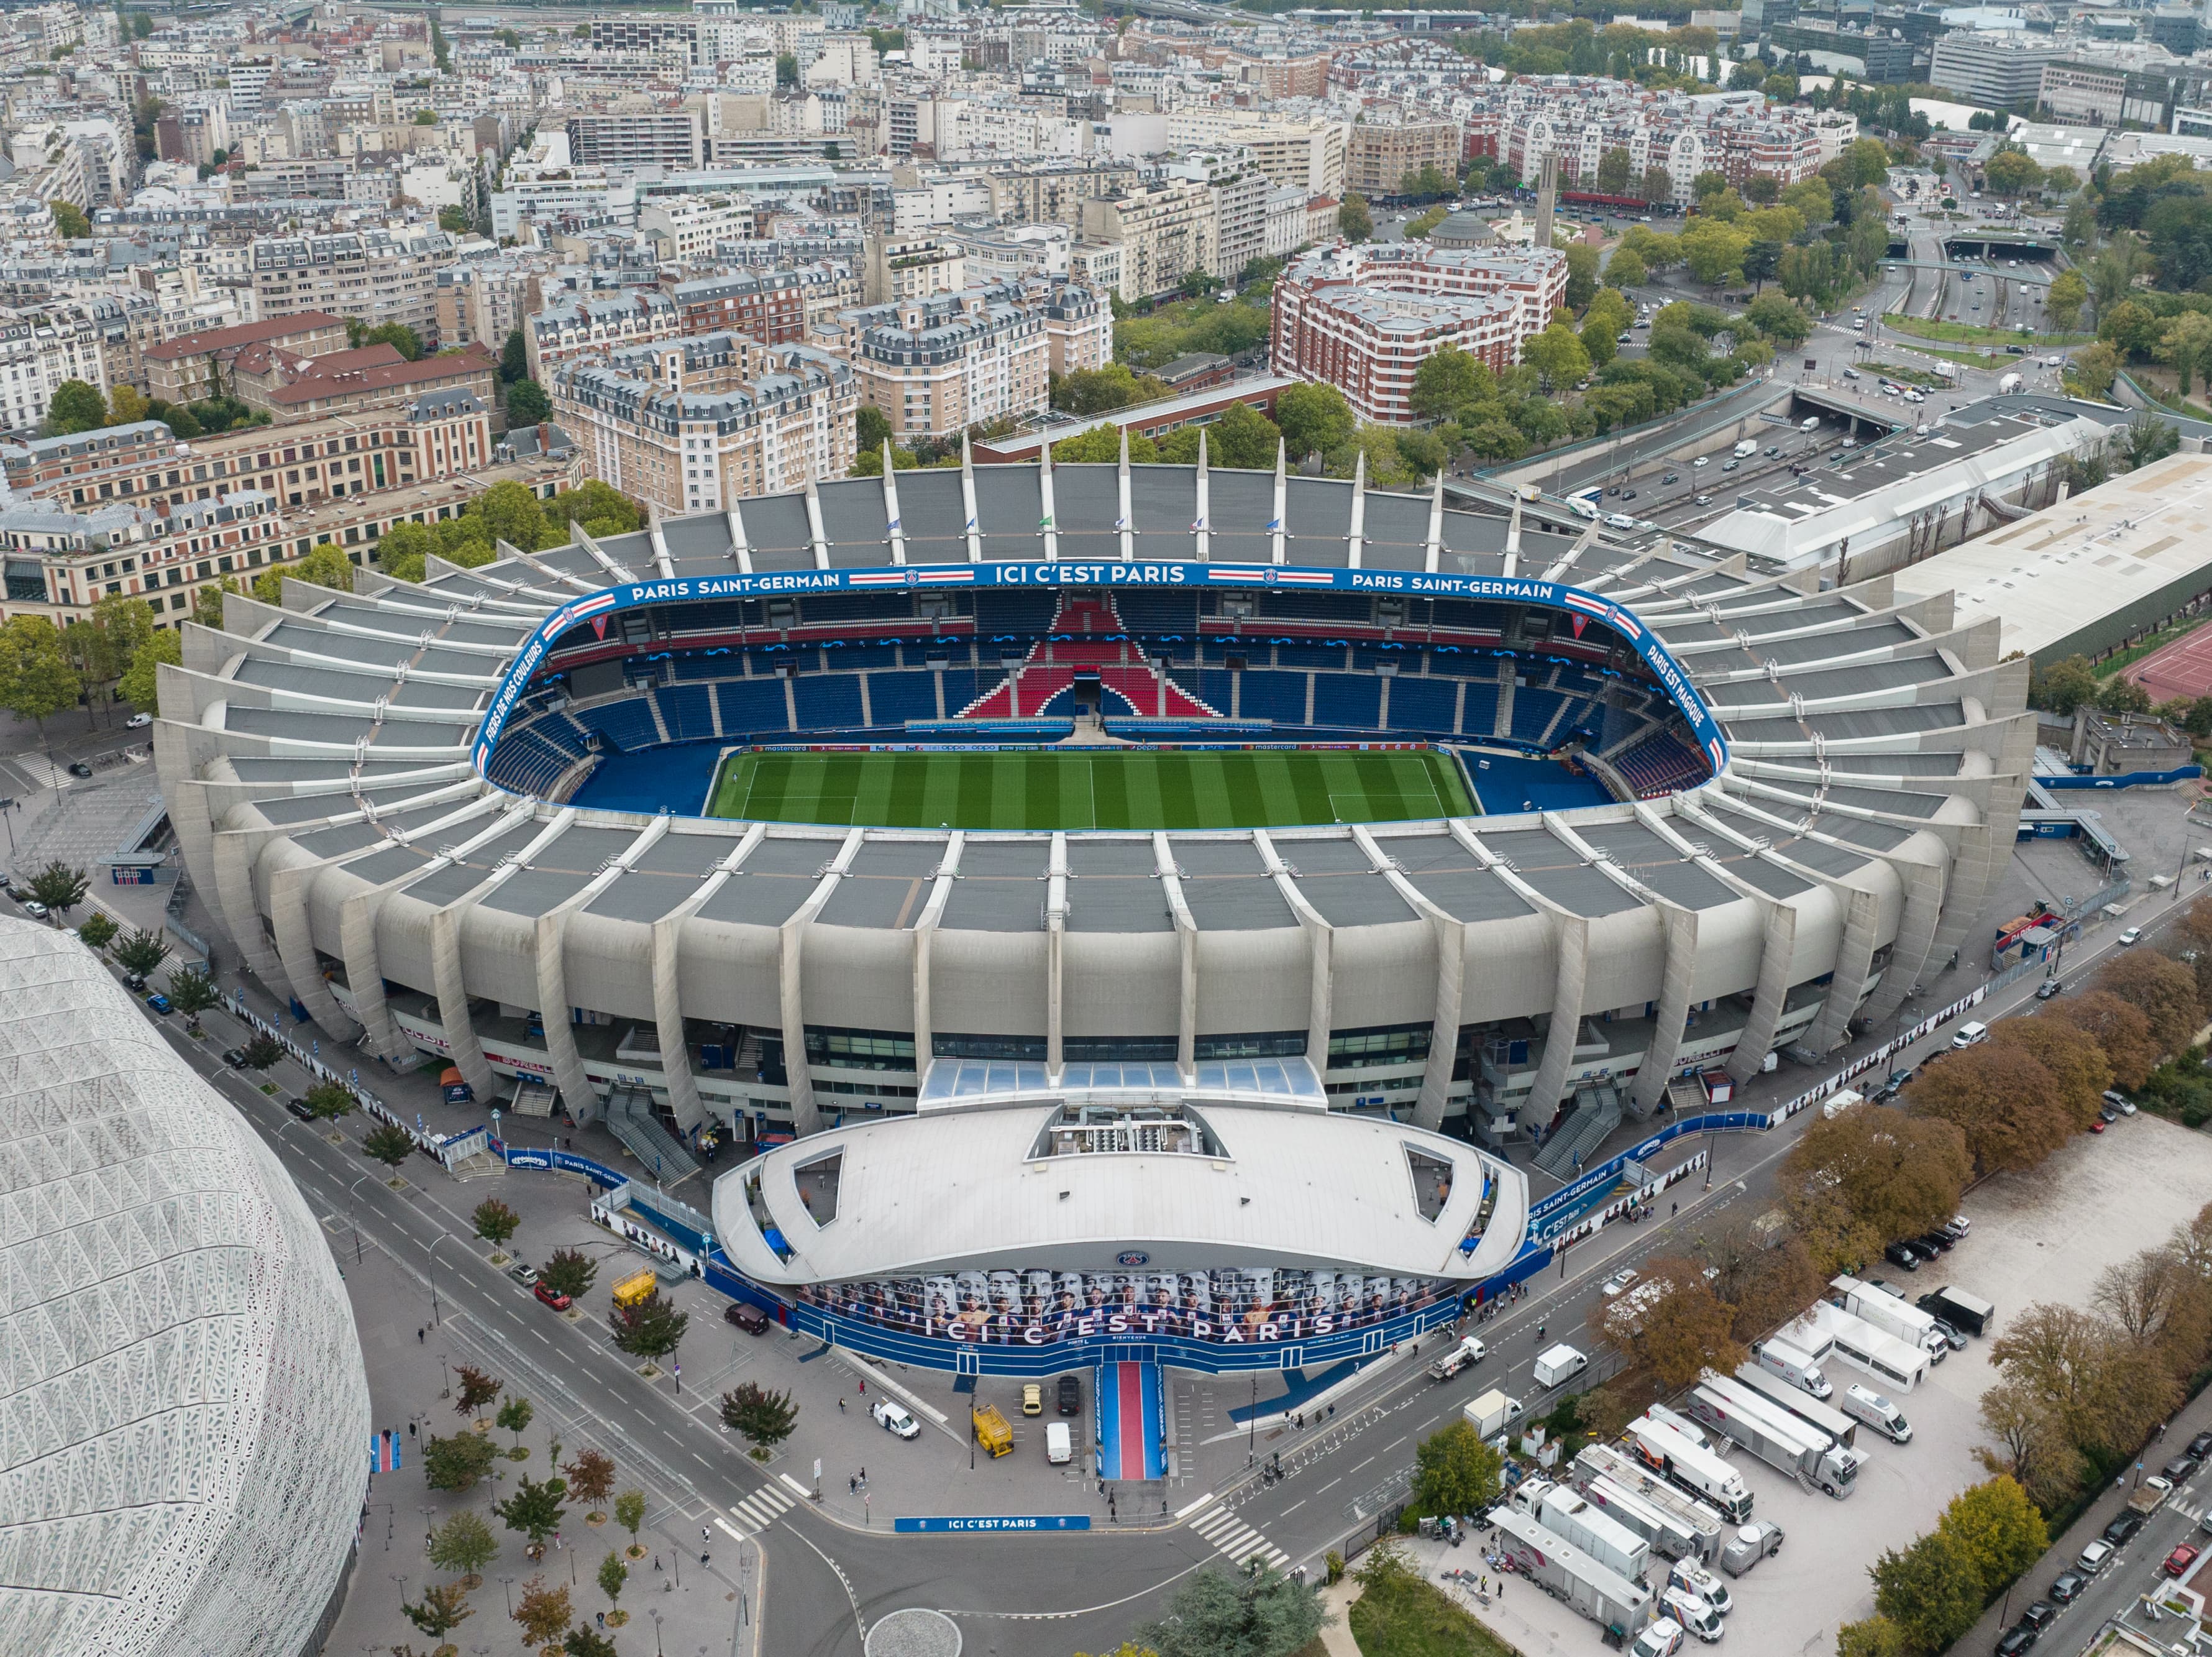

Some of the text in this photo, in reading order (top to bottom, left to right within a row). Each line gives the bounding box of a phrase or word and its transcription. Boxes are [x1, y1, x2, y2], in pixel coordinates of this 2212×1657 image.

[632, 574, 839, 600] PARIS SAINT-GERMAIN
[996, 566, 1185, 583] ICI C'EST PARIS
[1352, 574, 1553, 599] PARIS SAINT-GERMAIN
[485, 640, 542, 743] FIERS DE NOS COULEURS
[1647, 645, 1704, 728] PARIS EST MAGIQUE
[564, 1160, 584, 1169] PARIS
[1543, 1170, 1607, 1212] SAINT-GERMAIN
[1543, 1216, 1568, 1240] C'EST
[926, 1319, 987, 1343] ICI
[1024, 1315, 1159, 1344] C'EST
[1194, 1316, 1333, 1343] PARIS
[948, 1519, 1036, 1529] ICI C'EST PARIS
